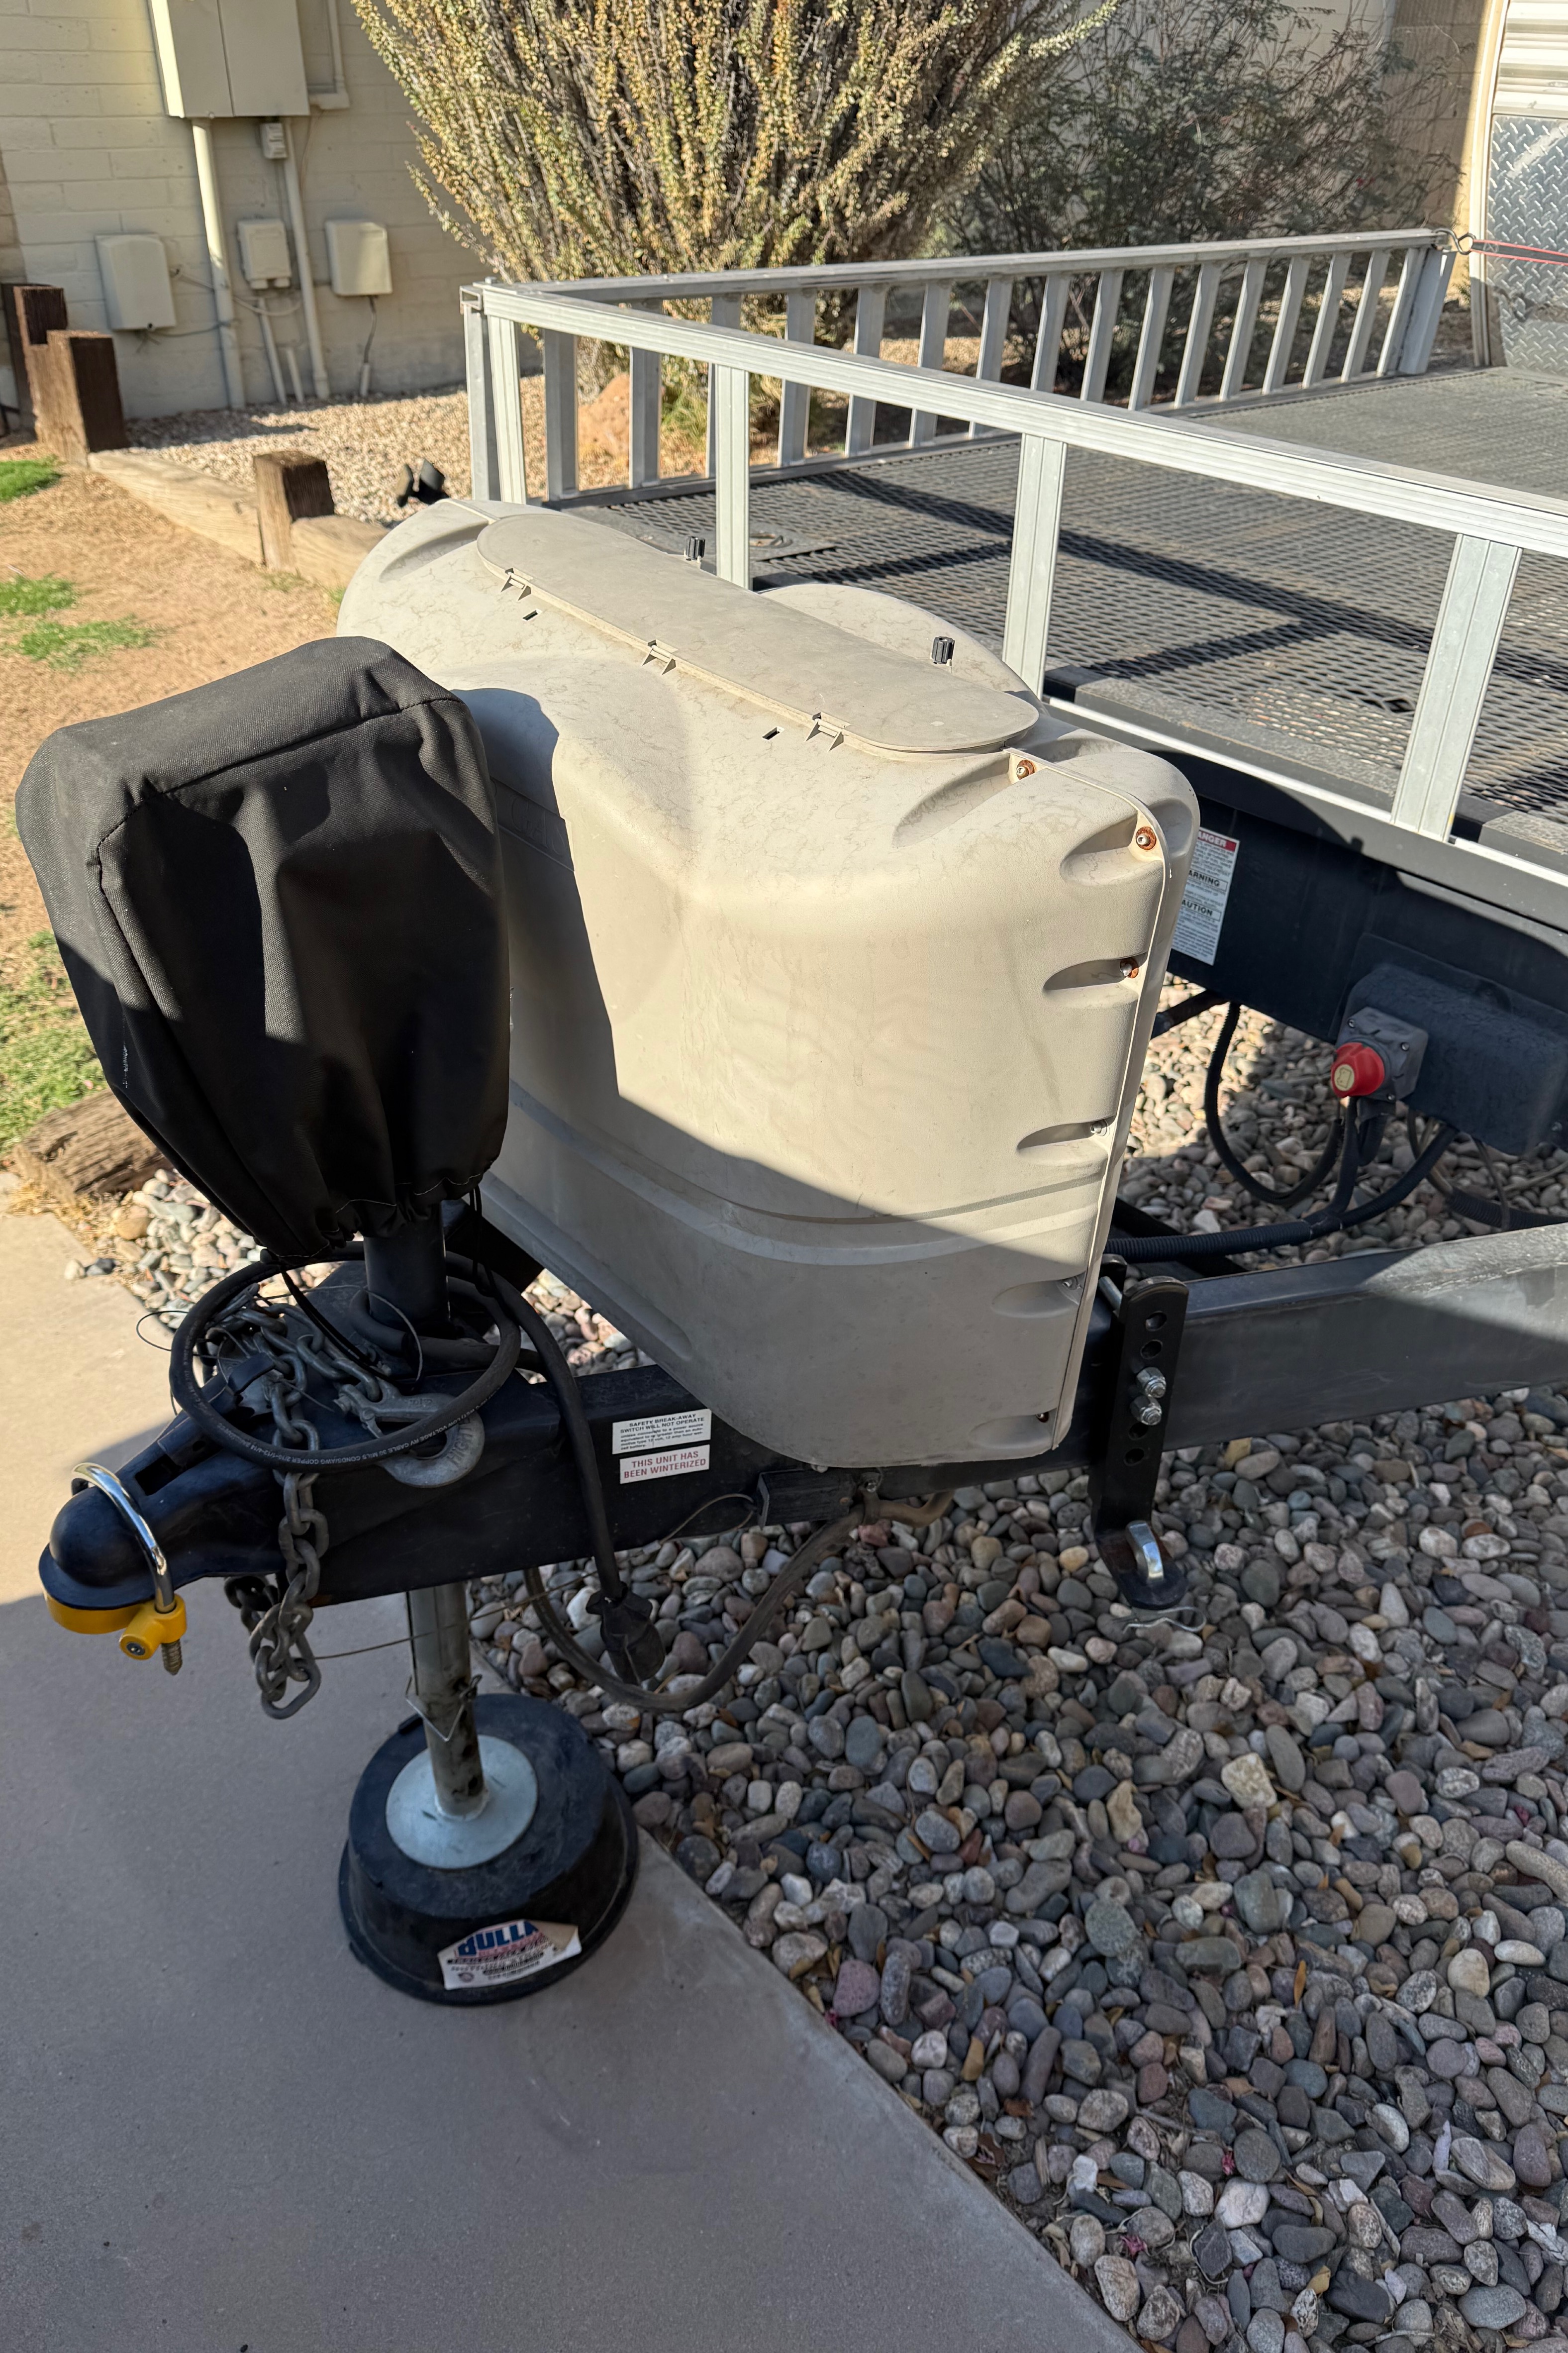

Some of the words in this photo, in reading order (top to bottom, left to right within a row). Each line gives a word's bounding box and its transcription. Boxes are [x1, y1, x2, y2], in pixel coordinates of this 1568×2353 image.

[1198, 831, 1227, 847] ANGER
[1189, 870, 1220, 887] ARNING
[1181, 900, 1213, 917] AUTION
[448, 1417, 461, 1427] LOW
[655, 1414, 696, 1423] BREAK-AWAY
[419, 1426, 447, 1442] VOLTAGE
[388, 1442, 408, 1453] CABLE
[631, 1458, 653, 1468] THIS
[656, 1454, 678, 1464] UNIT
[681, 1451, 698, 1460] HAS
[624, 1468, 647, 1478] BEEN
[650, 1458, 706, 1474] WINTERIZED
[458, 1920, 539, 1956] BULL
